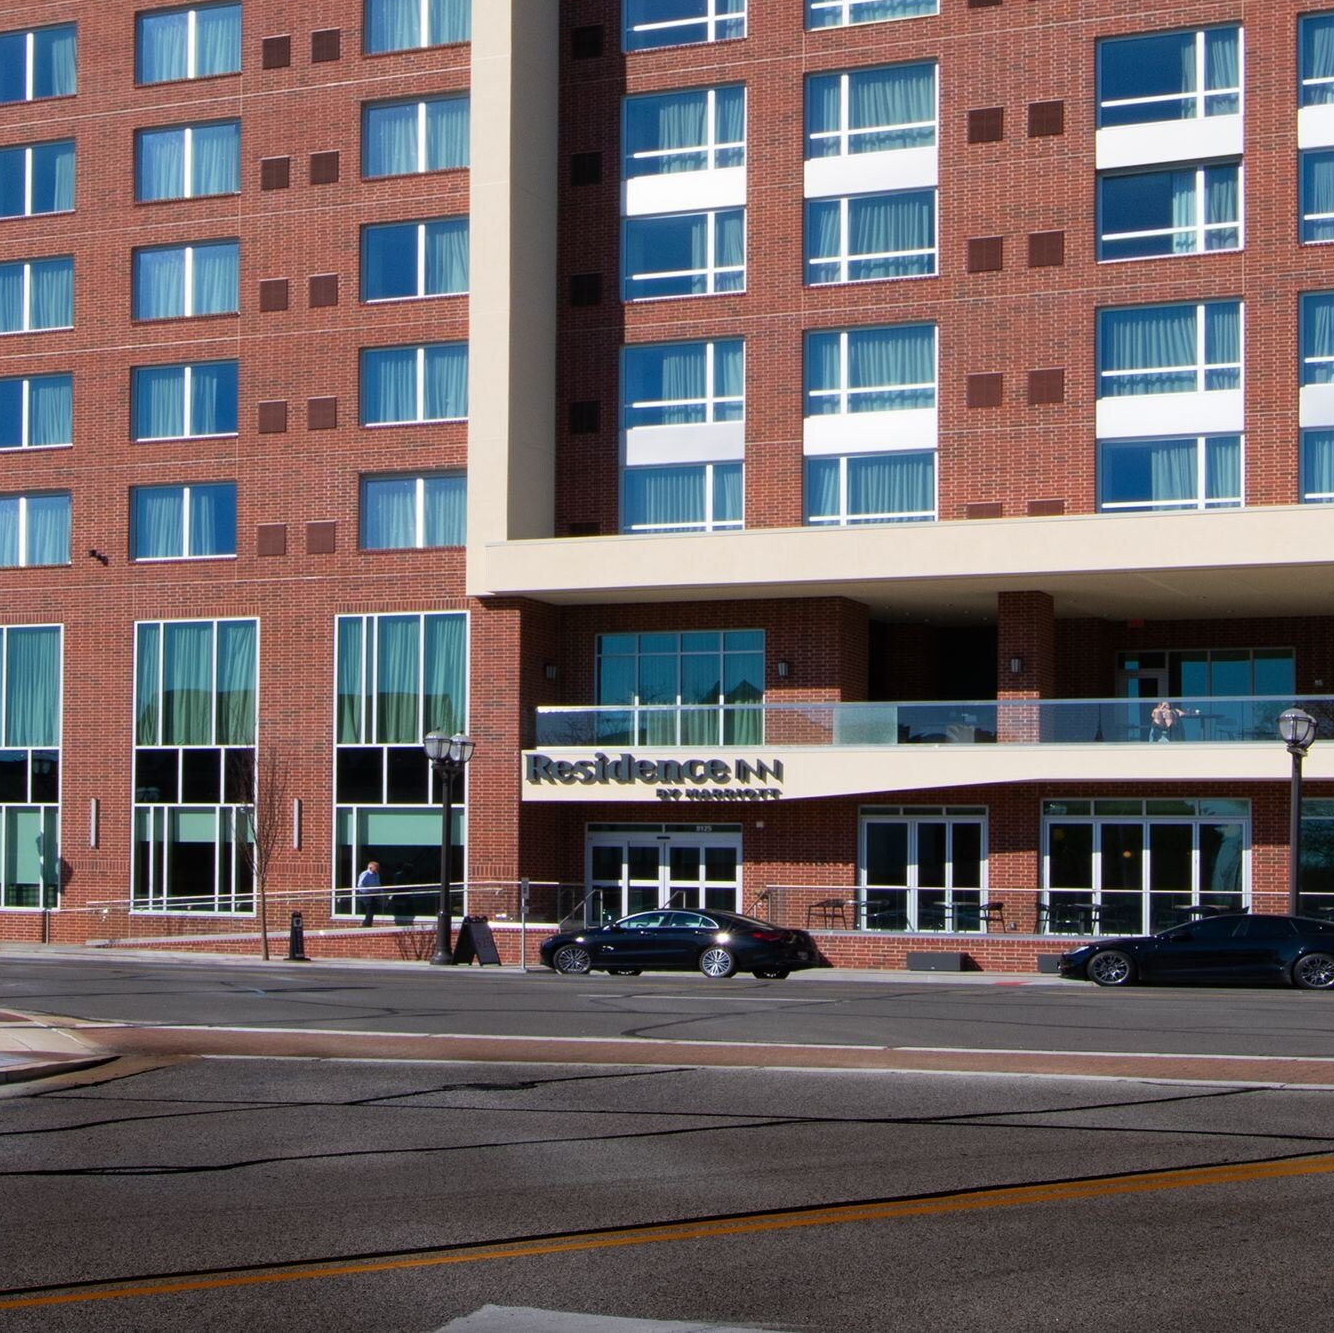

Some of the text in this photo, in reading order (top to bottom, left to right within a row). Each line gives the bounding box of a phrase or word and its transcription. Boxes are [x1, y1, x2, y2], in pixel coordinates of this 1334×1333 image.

[525, 752, 784, 785] Residence INN
[656, 788, 782, 800] BY MARRIOTT
